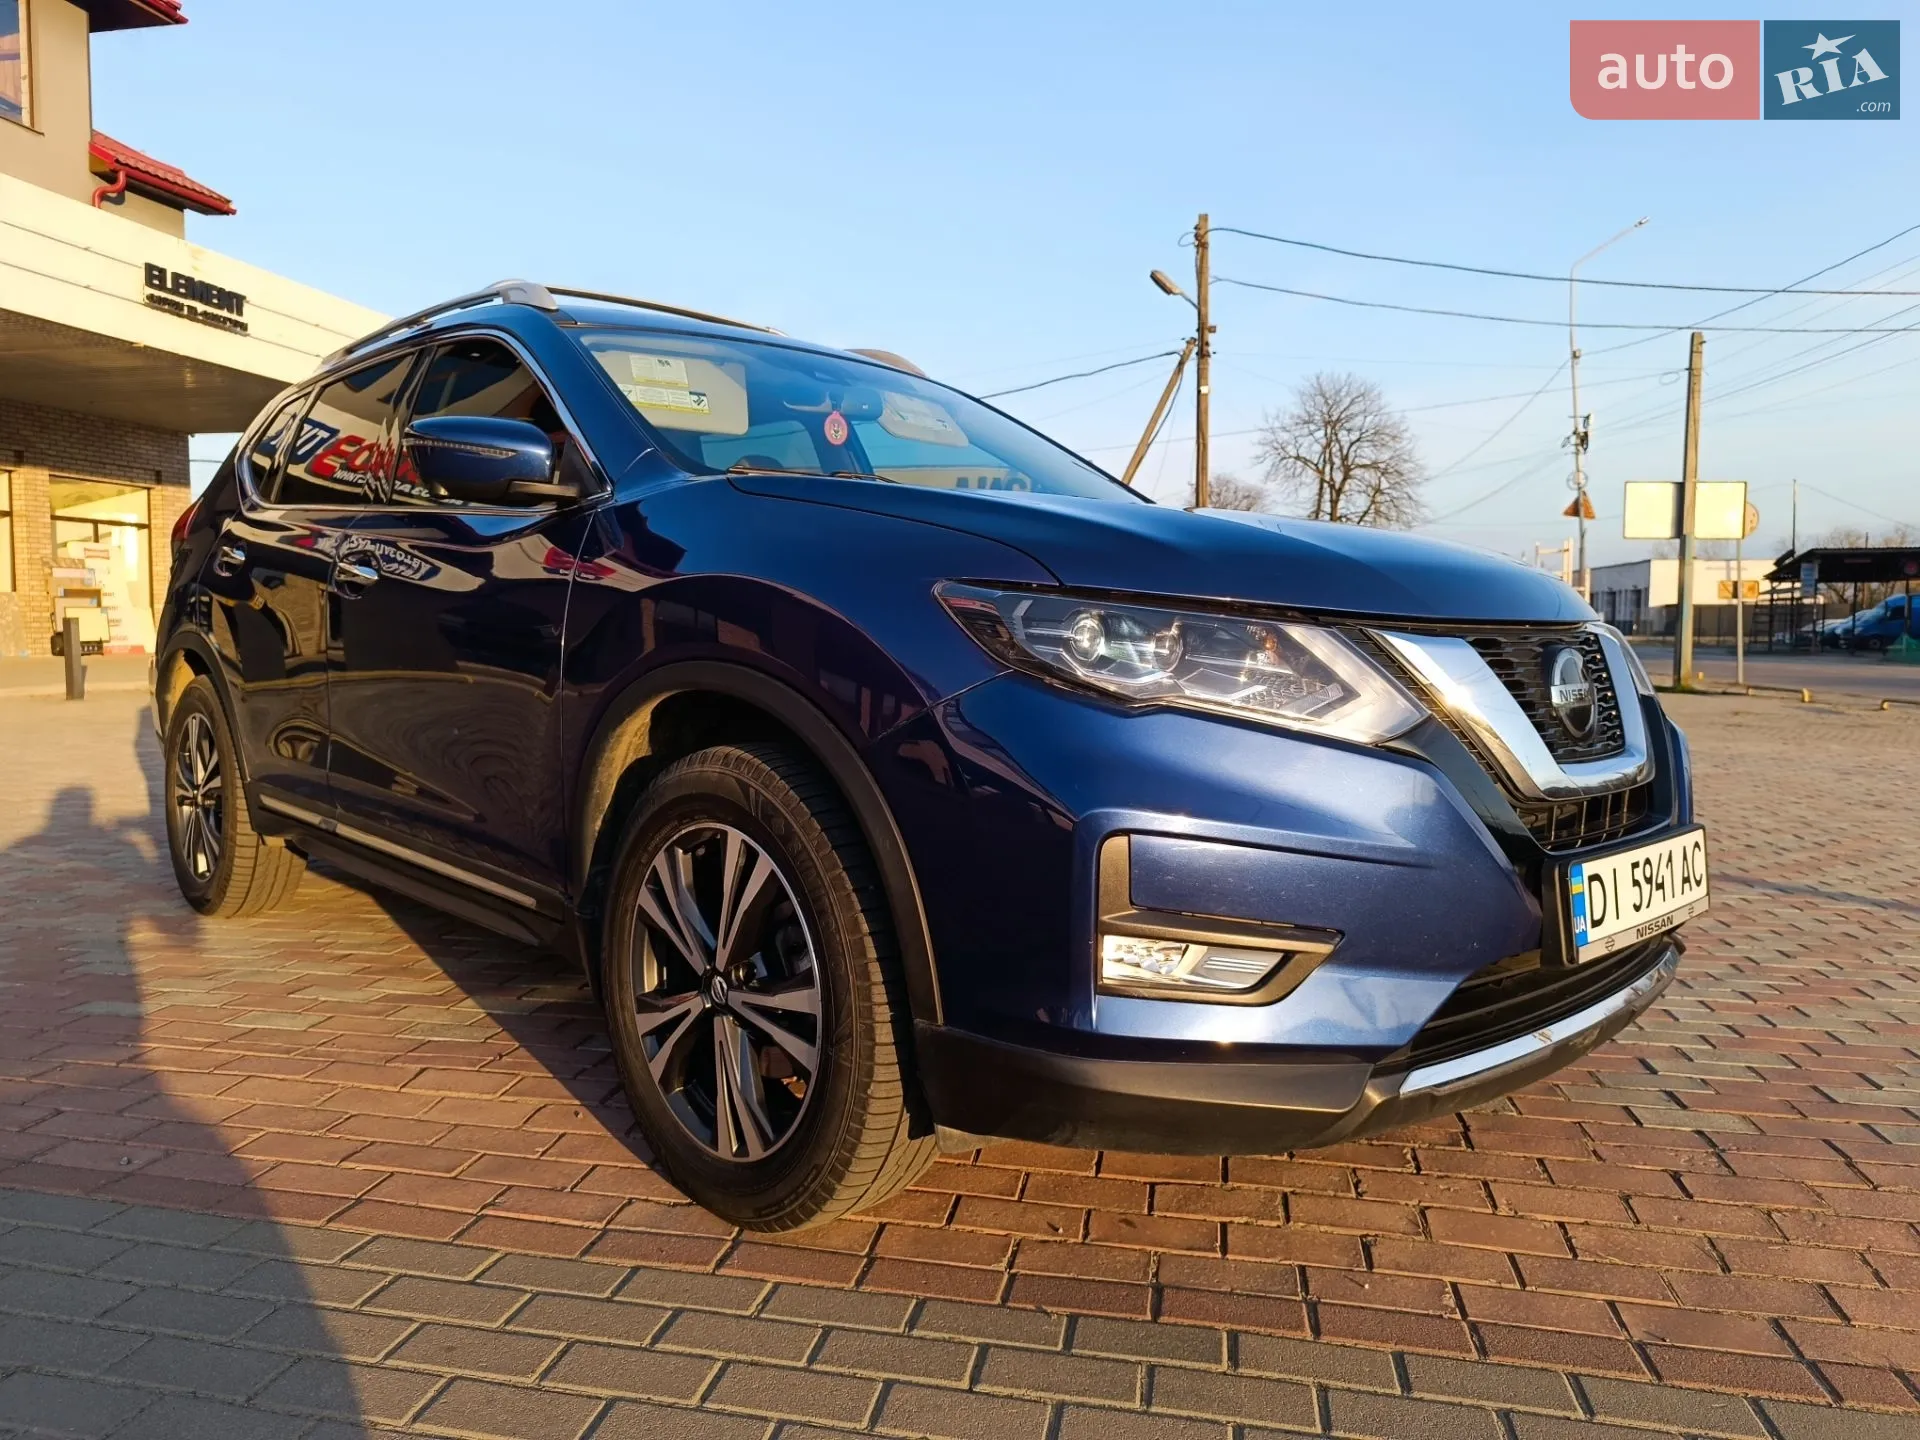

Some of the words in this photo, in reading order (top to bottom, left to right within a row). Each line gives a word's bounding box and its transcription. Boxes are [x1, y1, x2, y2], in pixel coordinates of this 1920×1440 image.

[144, 262, 247, 317] ELEMENT
[1559, 687, 1593, 702] NISS
[1587, 867, 1620, 929] DI
[1630, 849, 1675, 913] 5941
[1681, 840, 1703, 896] AC
[1574, 915, 1586, 934] UA
[1635, 914, 1674, 940] NISSAN
